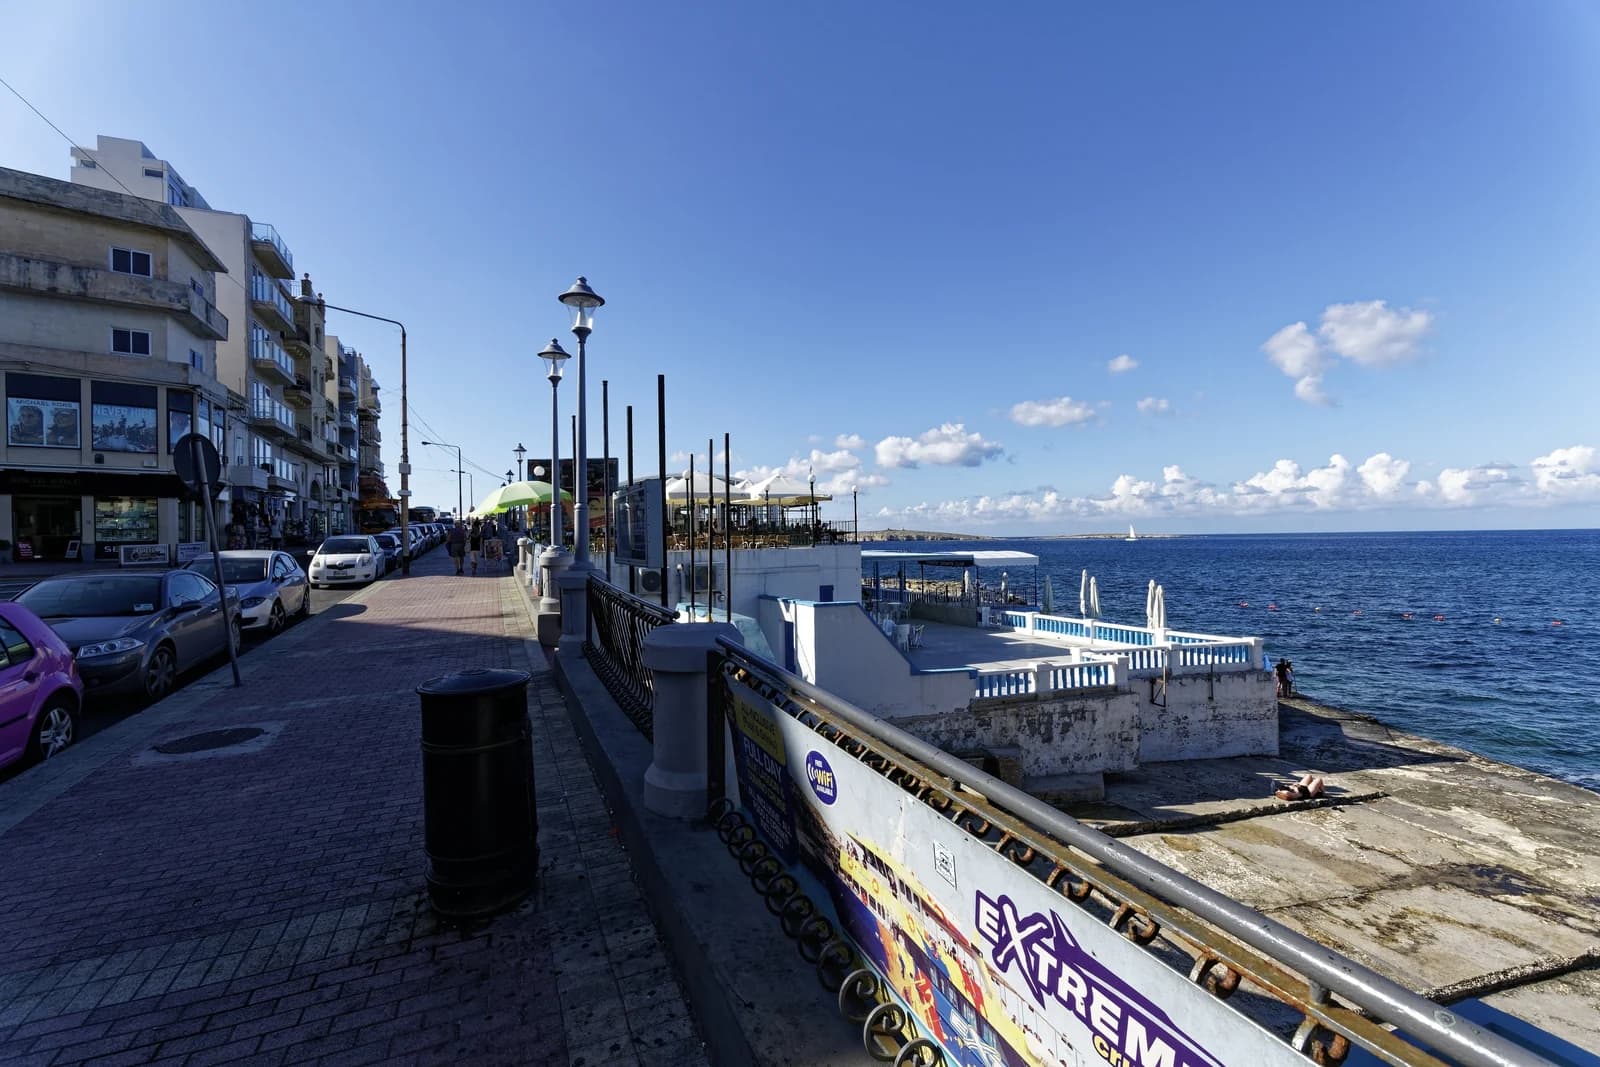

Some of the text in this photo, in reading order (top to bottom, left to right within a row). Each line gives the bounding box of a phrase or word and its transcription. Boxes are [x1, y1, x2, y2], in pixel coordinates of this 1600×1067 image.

[763, 752, 781, 782] DAY
[817, 769, 833, 788] WiFi
[977, 897, 1192, 1067] EXTREM
